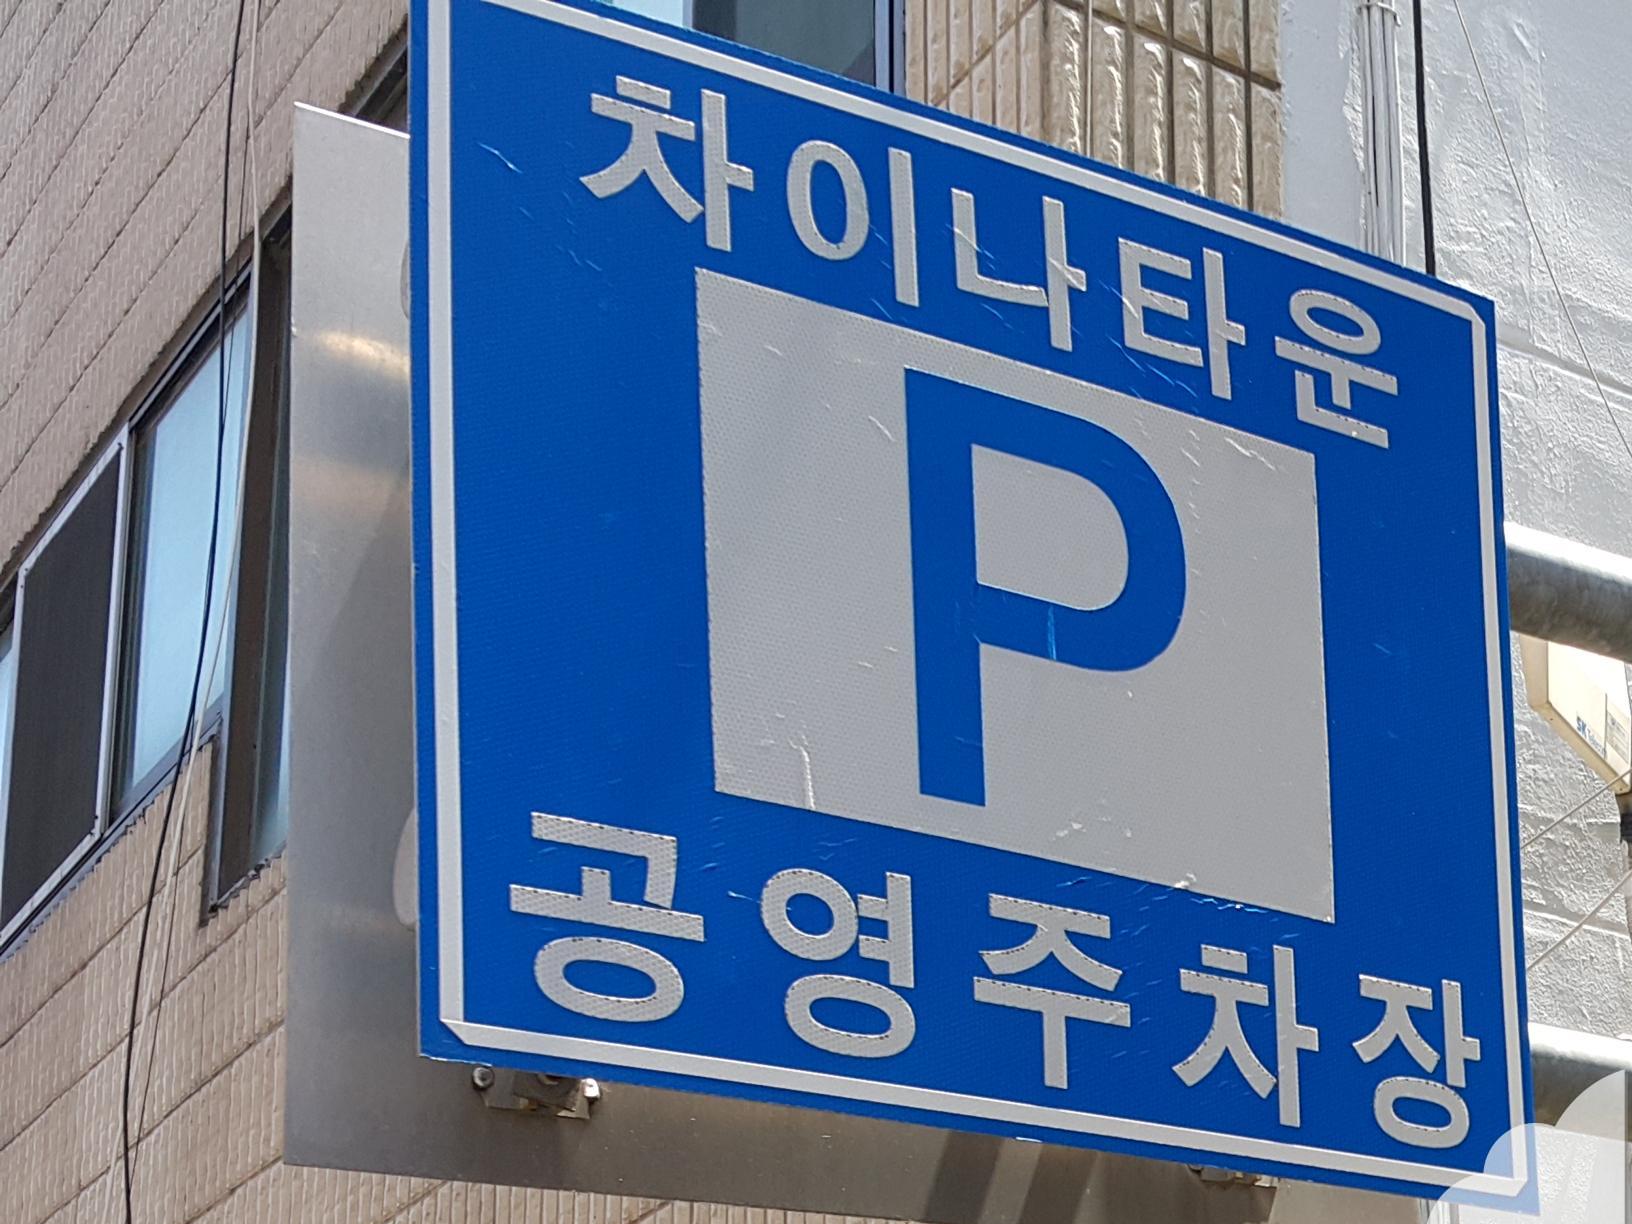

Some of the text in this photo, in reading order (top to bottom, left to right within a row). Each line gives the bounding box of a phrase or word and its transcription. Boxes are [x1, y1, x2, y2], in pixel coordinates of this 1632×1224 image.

[581, 75, 1398, 449] 차이나타운
[904, 366, 1187, 807] P
[509, 811, 1480, 1149] 공영주차장
